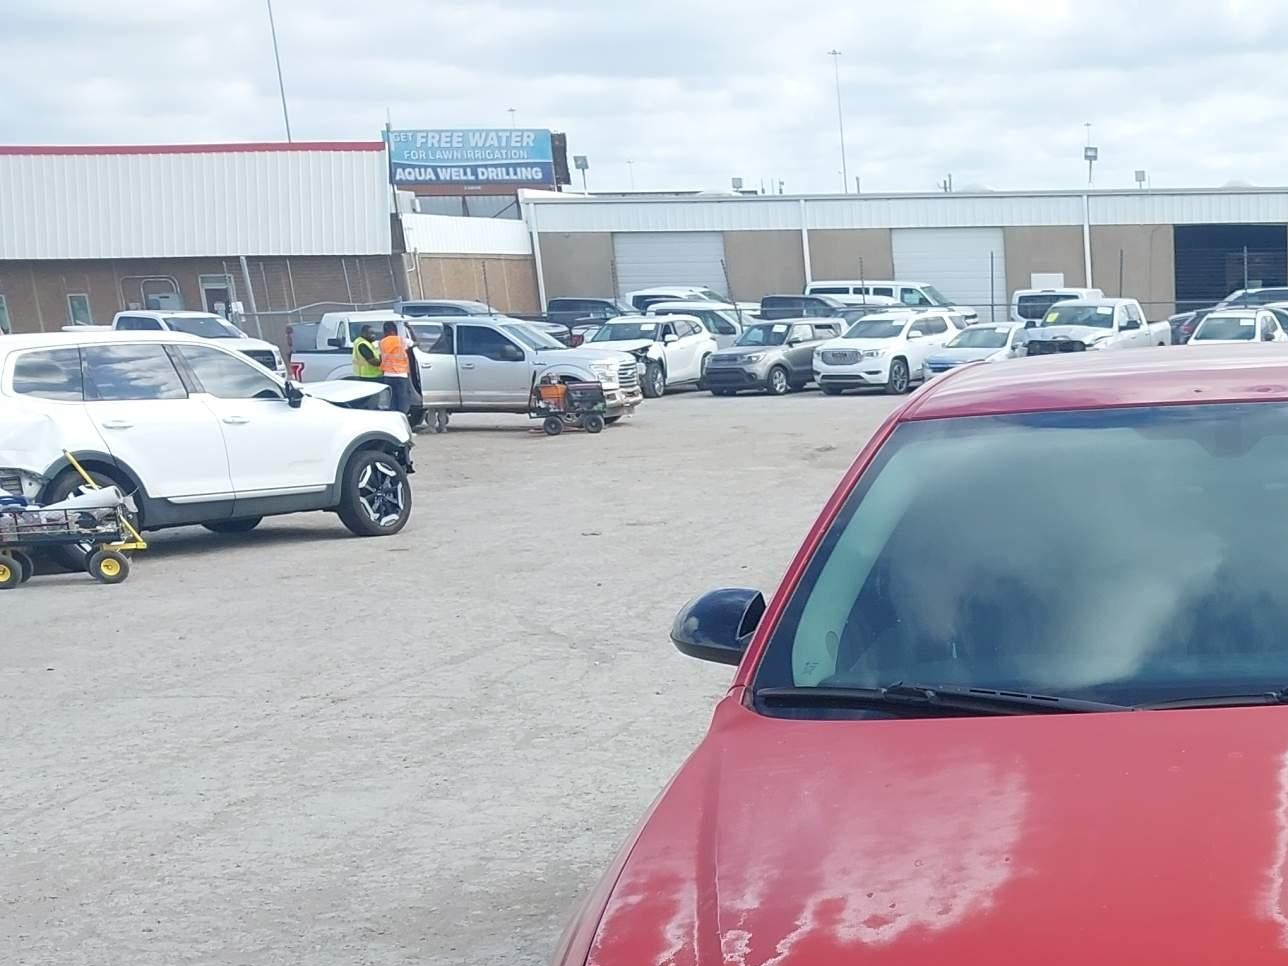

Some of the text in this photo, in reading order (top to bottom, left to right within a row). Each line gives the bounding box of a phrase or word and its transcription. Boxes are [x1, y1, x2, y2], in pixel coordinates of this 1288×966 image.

[416, 133, 464, 148] FREE
[466, 132, 535, 148] WATER
[404, 149, 528, 160] FOR LAWN IRRIGATION
[395, 167, 543, 181] AQUA WELL DRILLING
